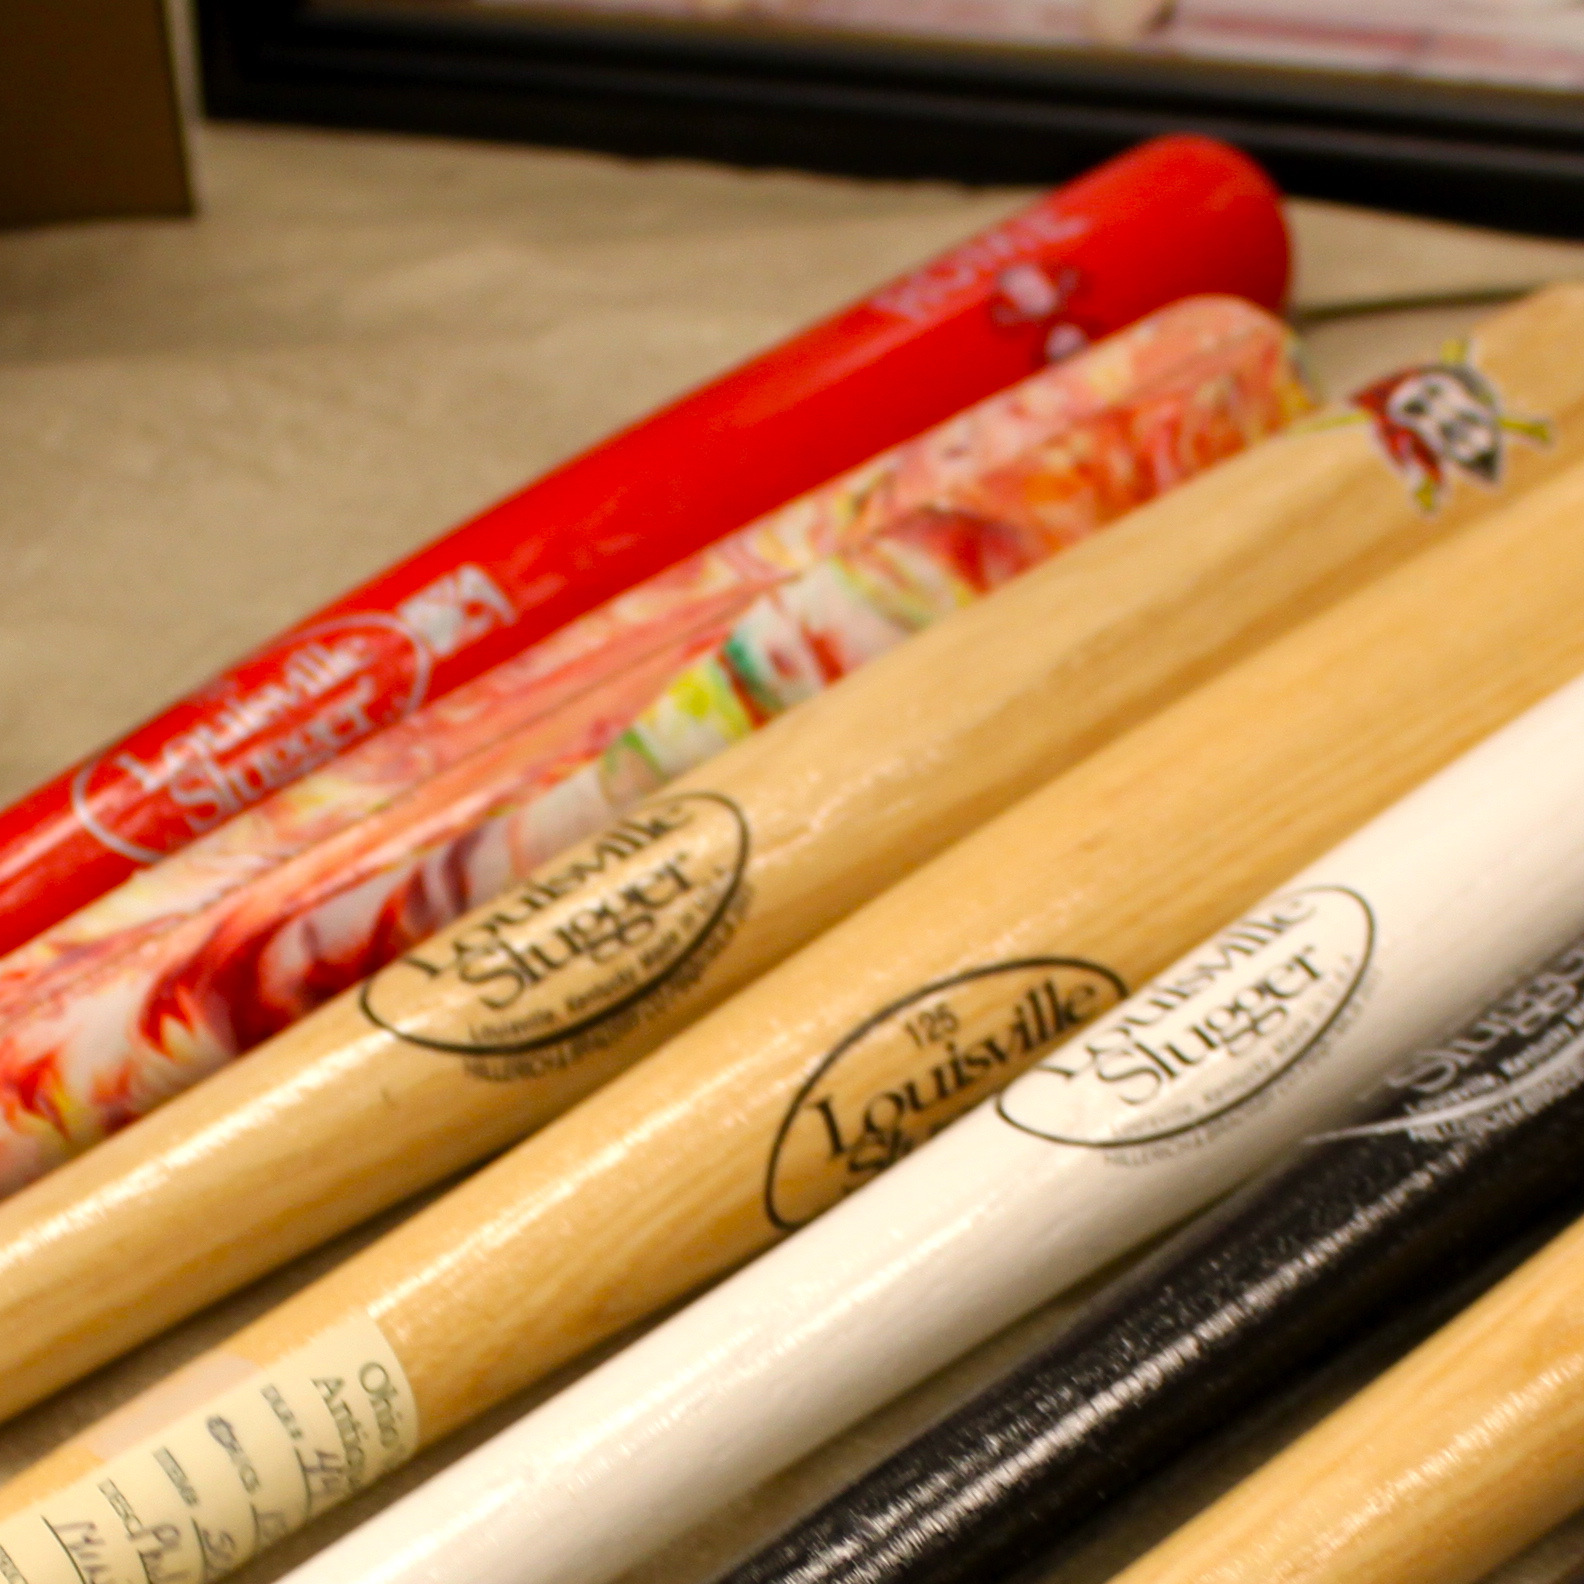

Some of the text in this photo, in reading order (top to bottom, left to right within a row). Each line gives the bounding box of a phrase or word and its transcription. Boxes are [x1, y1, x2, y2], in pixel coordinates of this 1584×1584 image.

[114, 631, 375, 793] Louisville
[454, 846, 693, 1015] Slugger
[1036, 896, 1317, 1084] Louisville
[811, 977, 1104, 1161] Louisville
[904, 1000, 959, 1050] 125
[1093, 943, 1328, 1112] Slugger
[353, 1358, 401, 1449] Ohio
